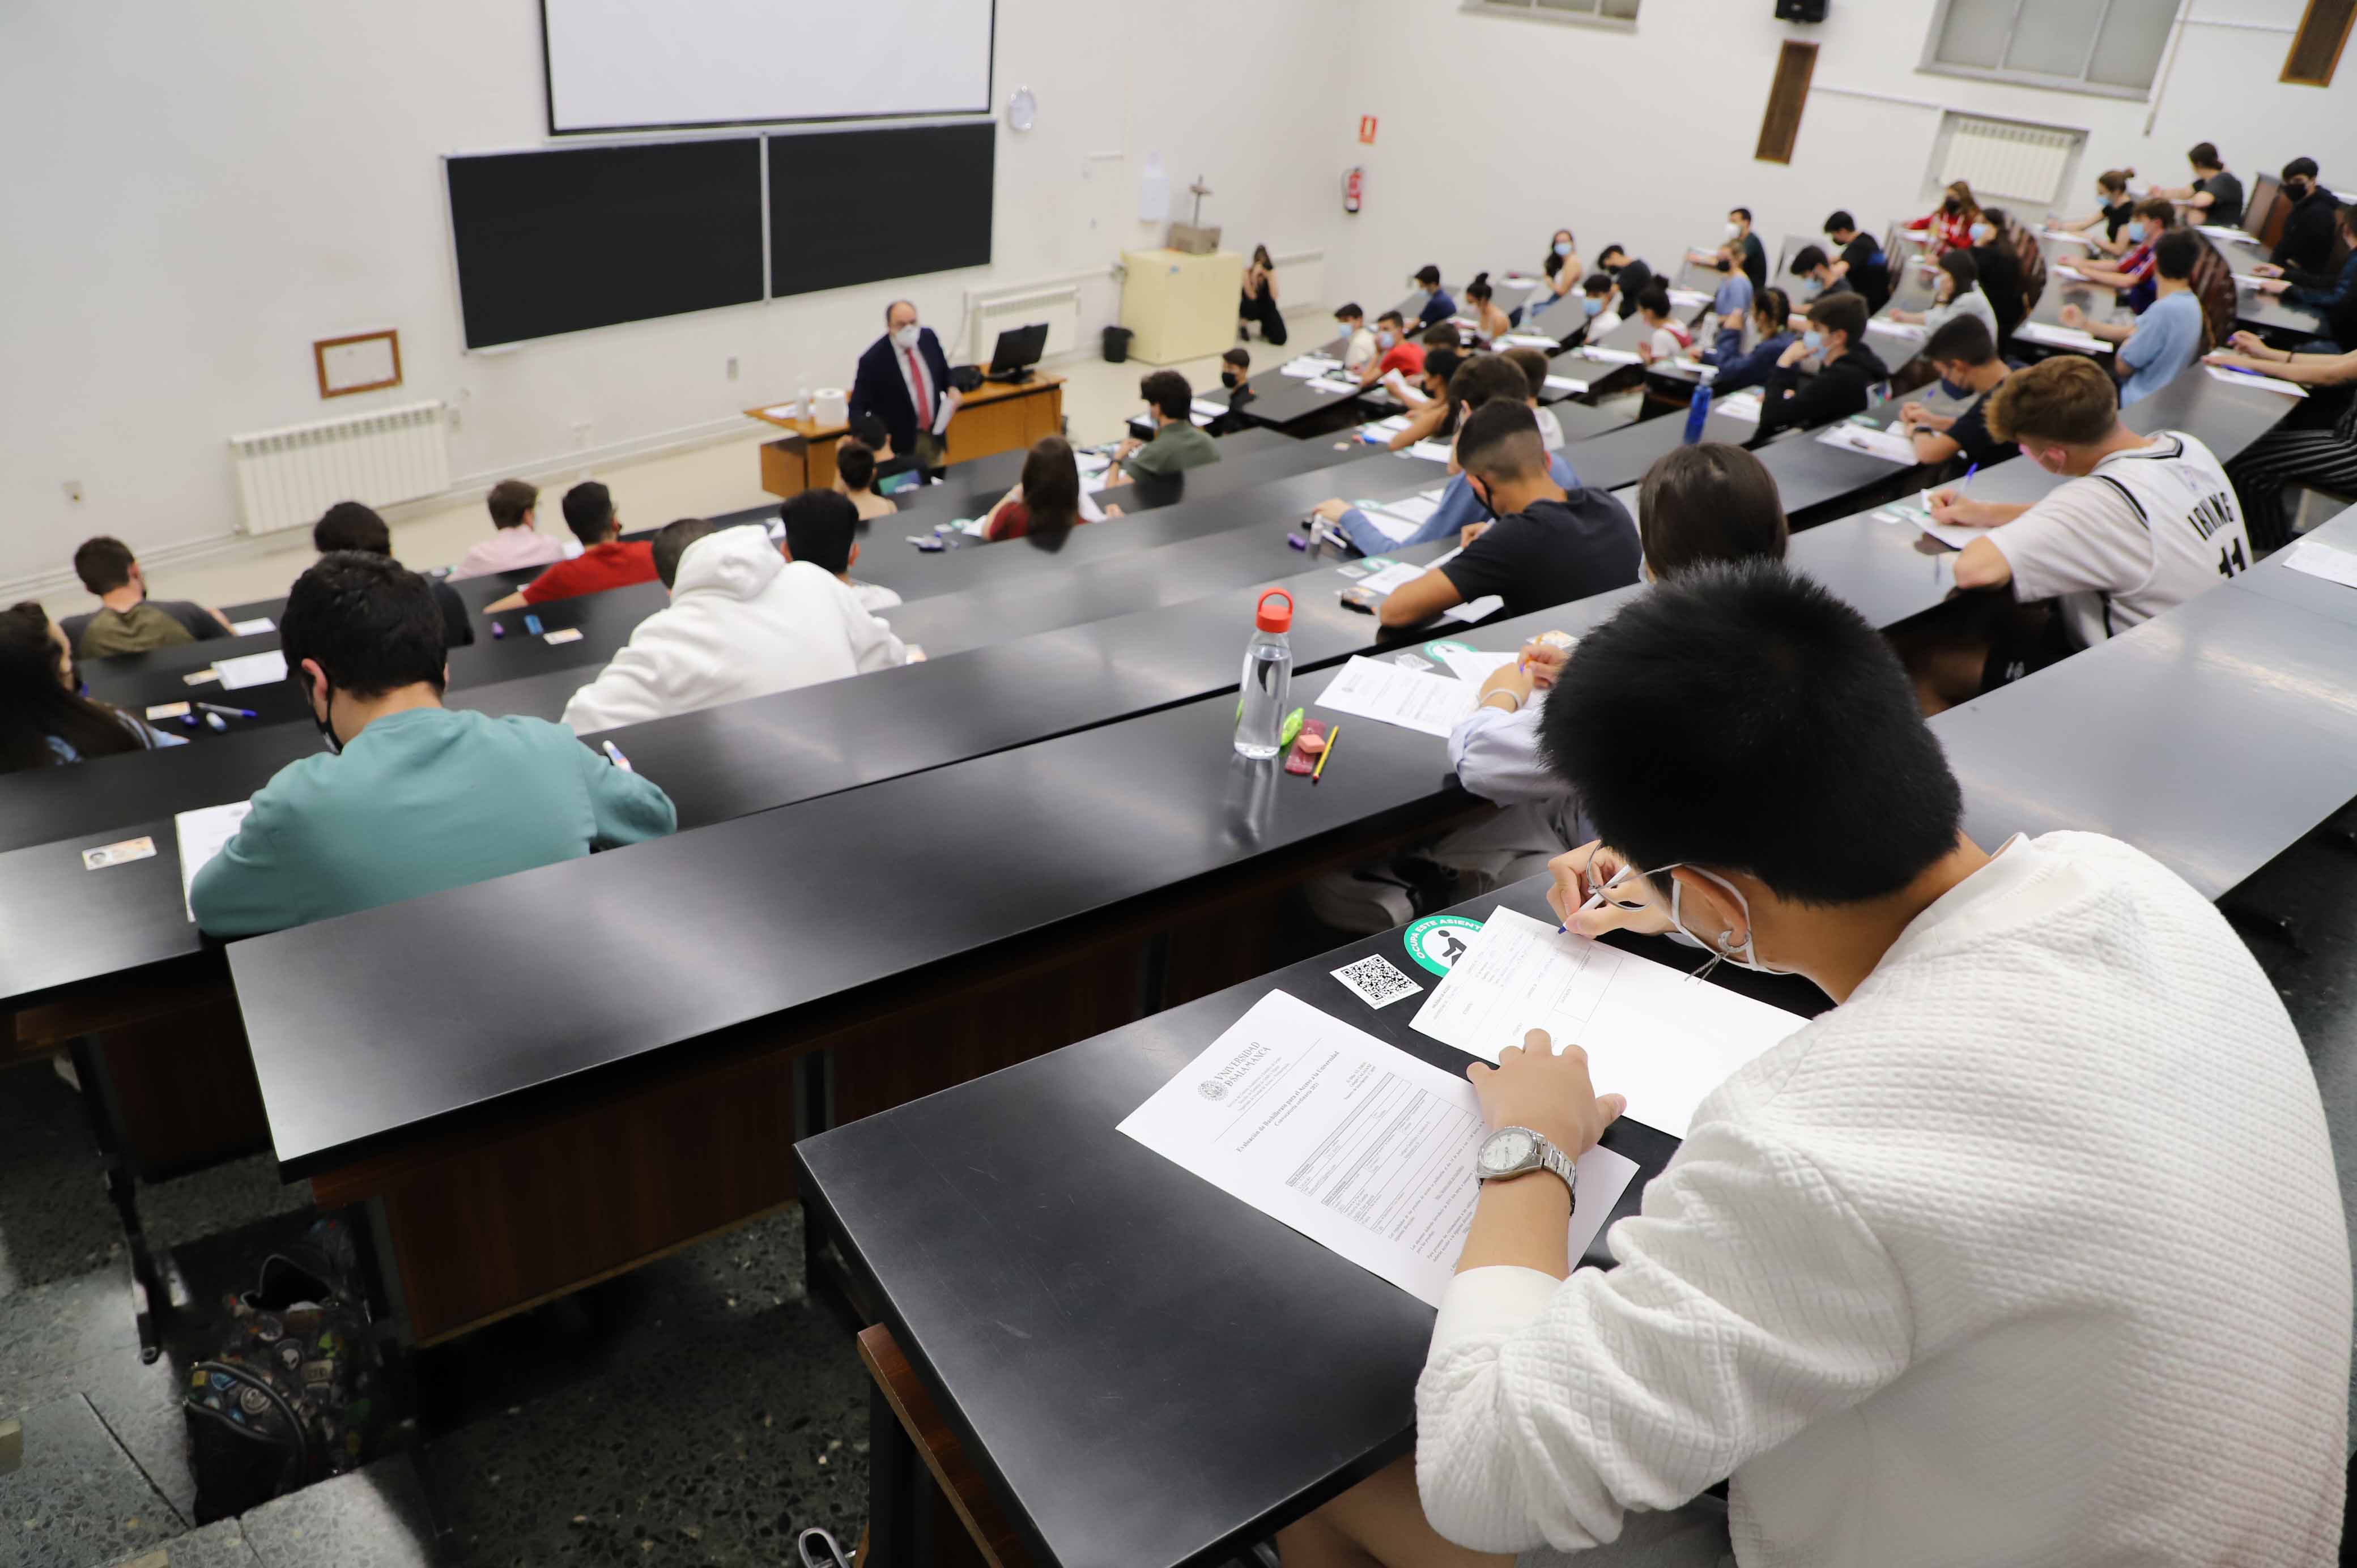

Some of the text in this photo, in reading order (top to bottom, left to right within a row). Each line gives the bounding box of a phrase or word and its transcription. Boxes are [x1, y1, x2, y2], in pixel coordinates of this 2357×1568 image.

[1410, 919, 1482, 959] OCUPA ESTE ASIENT
